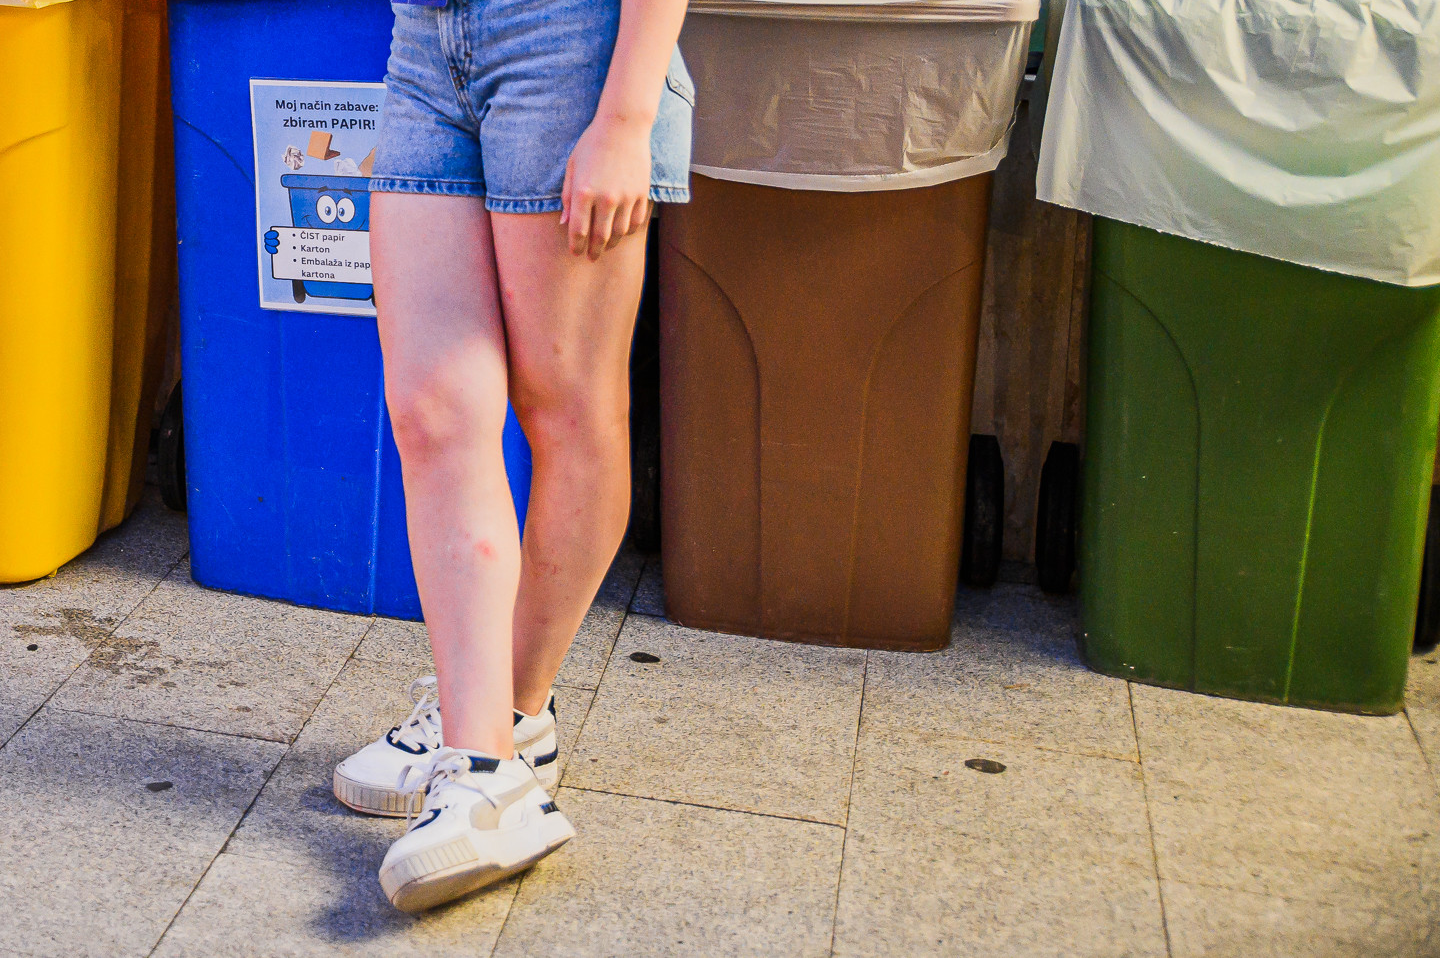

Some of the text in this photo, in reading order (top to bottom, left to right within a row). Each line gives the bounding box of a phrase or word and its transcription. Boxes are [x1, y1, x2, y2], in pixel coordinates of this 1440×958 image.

[275, 100, 379, 112] Moj način zabave:
[283, 116, 376, 130] zbiram PAPIR!
[300, 230, 345, 242] ČIST papir
[300, 244, 330, 253] Karton
[301, 257, 343, 267] Embalaža
[301, 269, 335, 279] kartona
